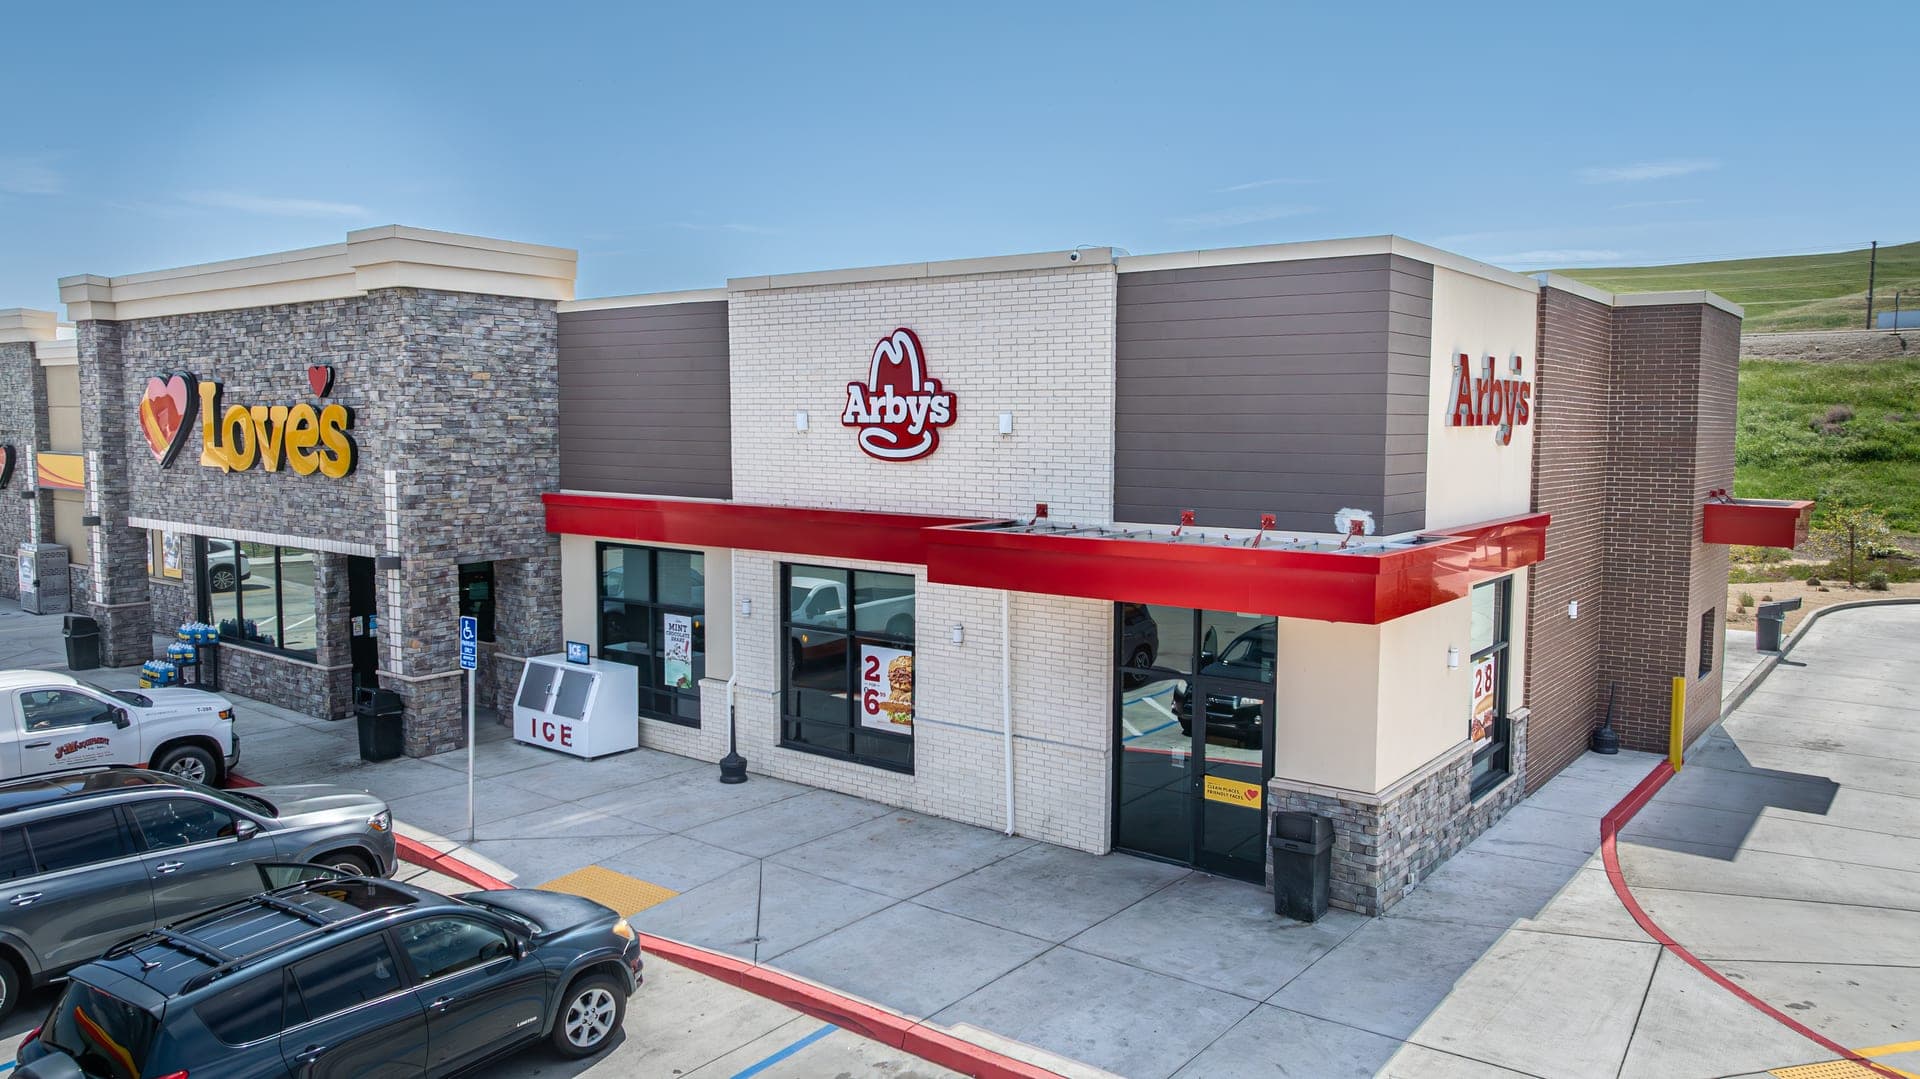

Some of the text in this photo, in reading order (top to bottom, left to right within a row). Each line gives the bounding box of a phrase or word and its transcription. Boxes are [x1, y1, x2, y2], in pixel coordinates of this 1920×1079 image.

[843, 382, 950, 434] Arby's
[1447, 353, 1531, 446] Arby's
[199, 368, 353, 479] Love's
[668, 623, 688, 632] MINT
[568, 643, 582, 656] ICE
[864, 655, 881, 682] 2
[1475, 664, 1492, 699] 2 8
[864, 689, 880, 715] 6
[532, 718, 573, 747] ICE
